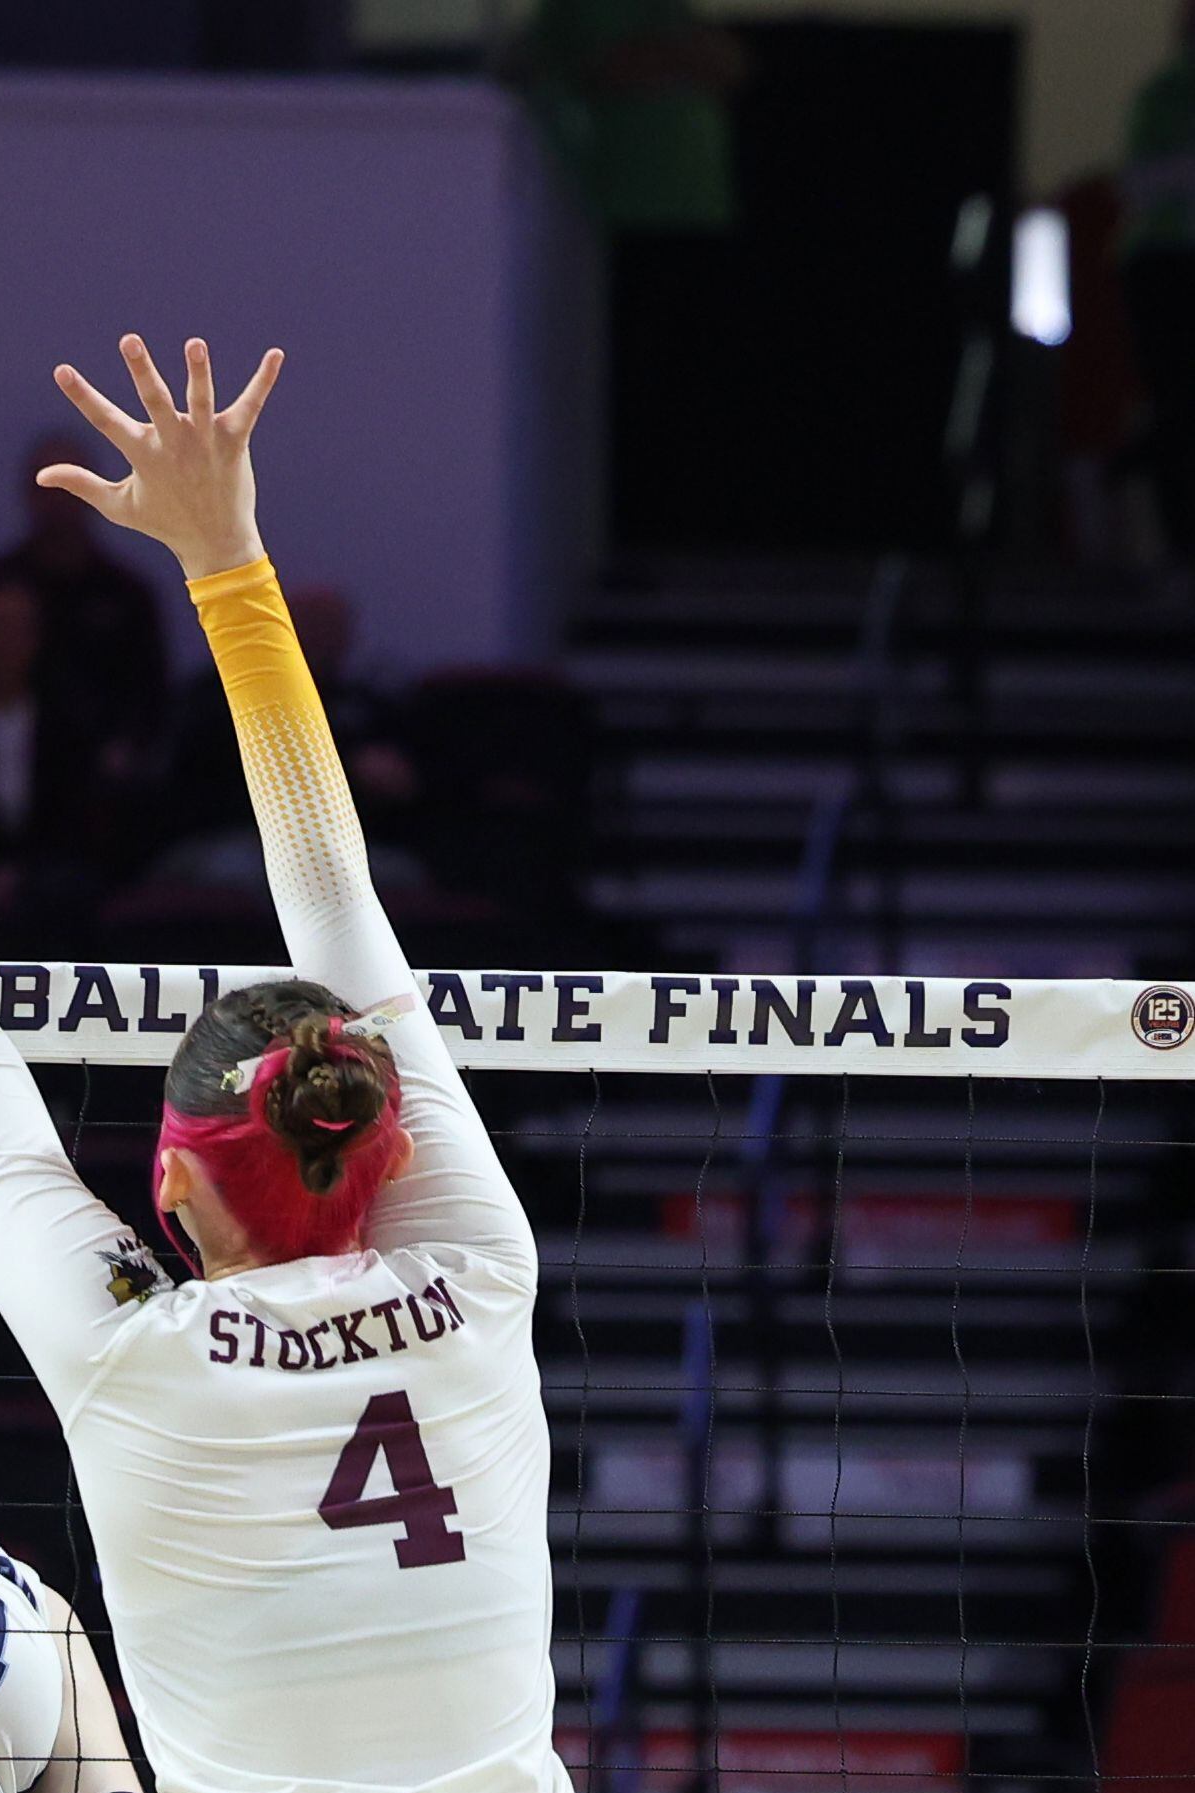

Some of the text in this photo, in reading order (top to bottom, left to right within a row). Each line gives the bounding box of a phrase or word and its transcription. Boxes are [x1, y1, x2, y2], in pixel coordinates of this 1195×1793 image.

[411, 972, 603, 1043] ATE
[648, 976, 1011, 1049] FINALS
[1148, 998, 1181, 1021] 125
[209, 1276, 466, 1370] STOCKTON
[317, 1389, 466, 1569] 4
